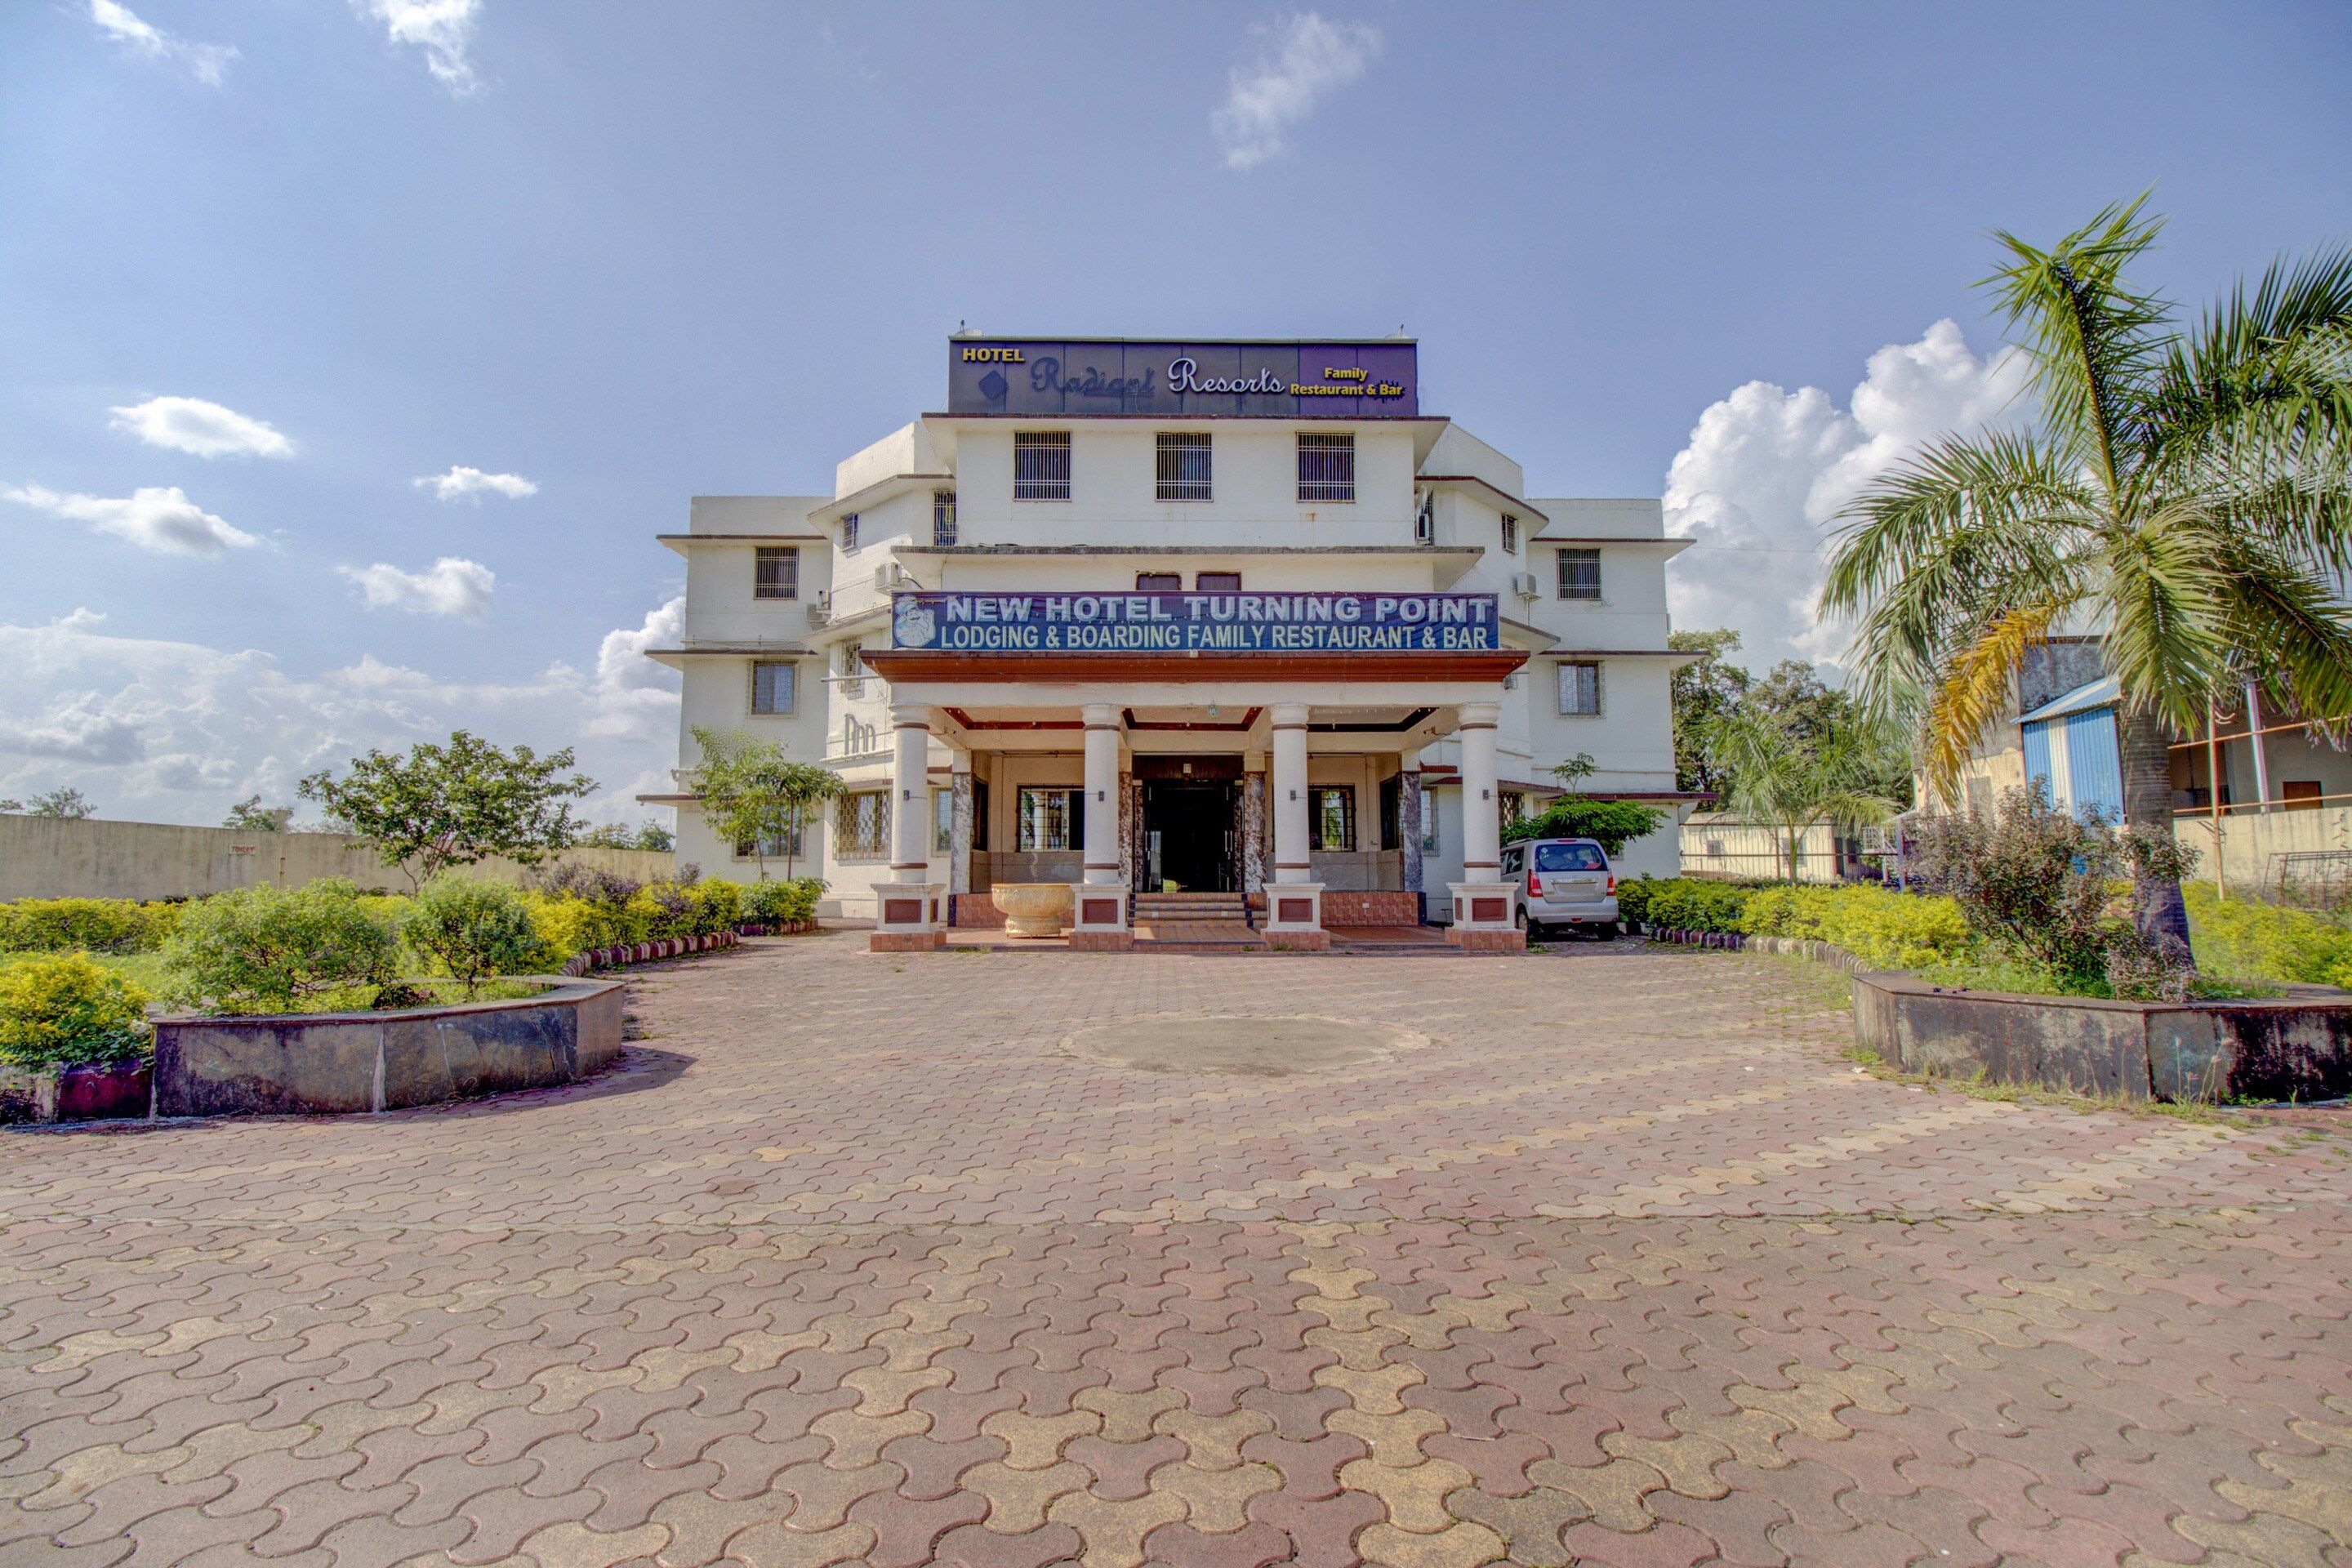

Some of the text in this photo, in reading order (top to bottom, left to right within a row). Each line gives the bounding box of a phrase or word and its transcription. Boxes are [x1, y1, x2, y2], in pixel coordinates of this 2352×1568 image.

[962, 348, 1026, 363] HOTEL
[1168, 358, 1285, 393] Resorts
[1324, 368, 1368, 381] Family
[1290, 383, 1402, 395] Restaurant & Bar
[947, 595, 1493, 623] NEW HOTEL TURNING POINT
[941, 626, 1490, 649] LODGING & BOARDING FAMILY RESTAURANT & BAR
